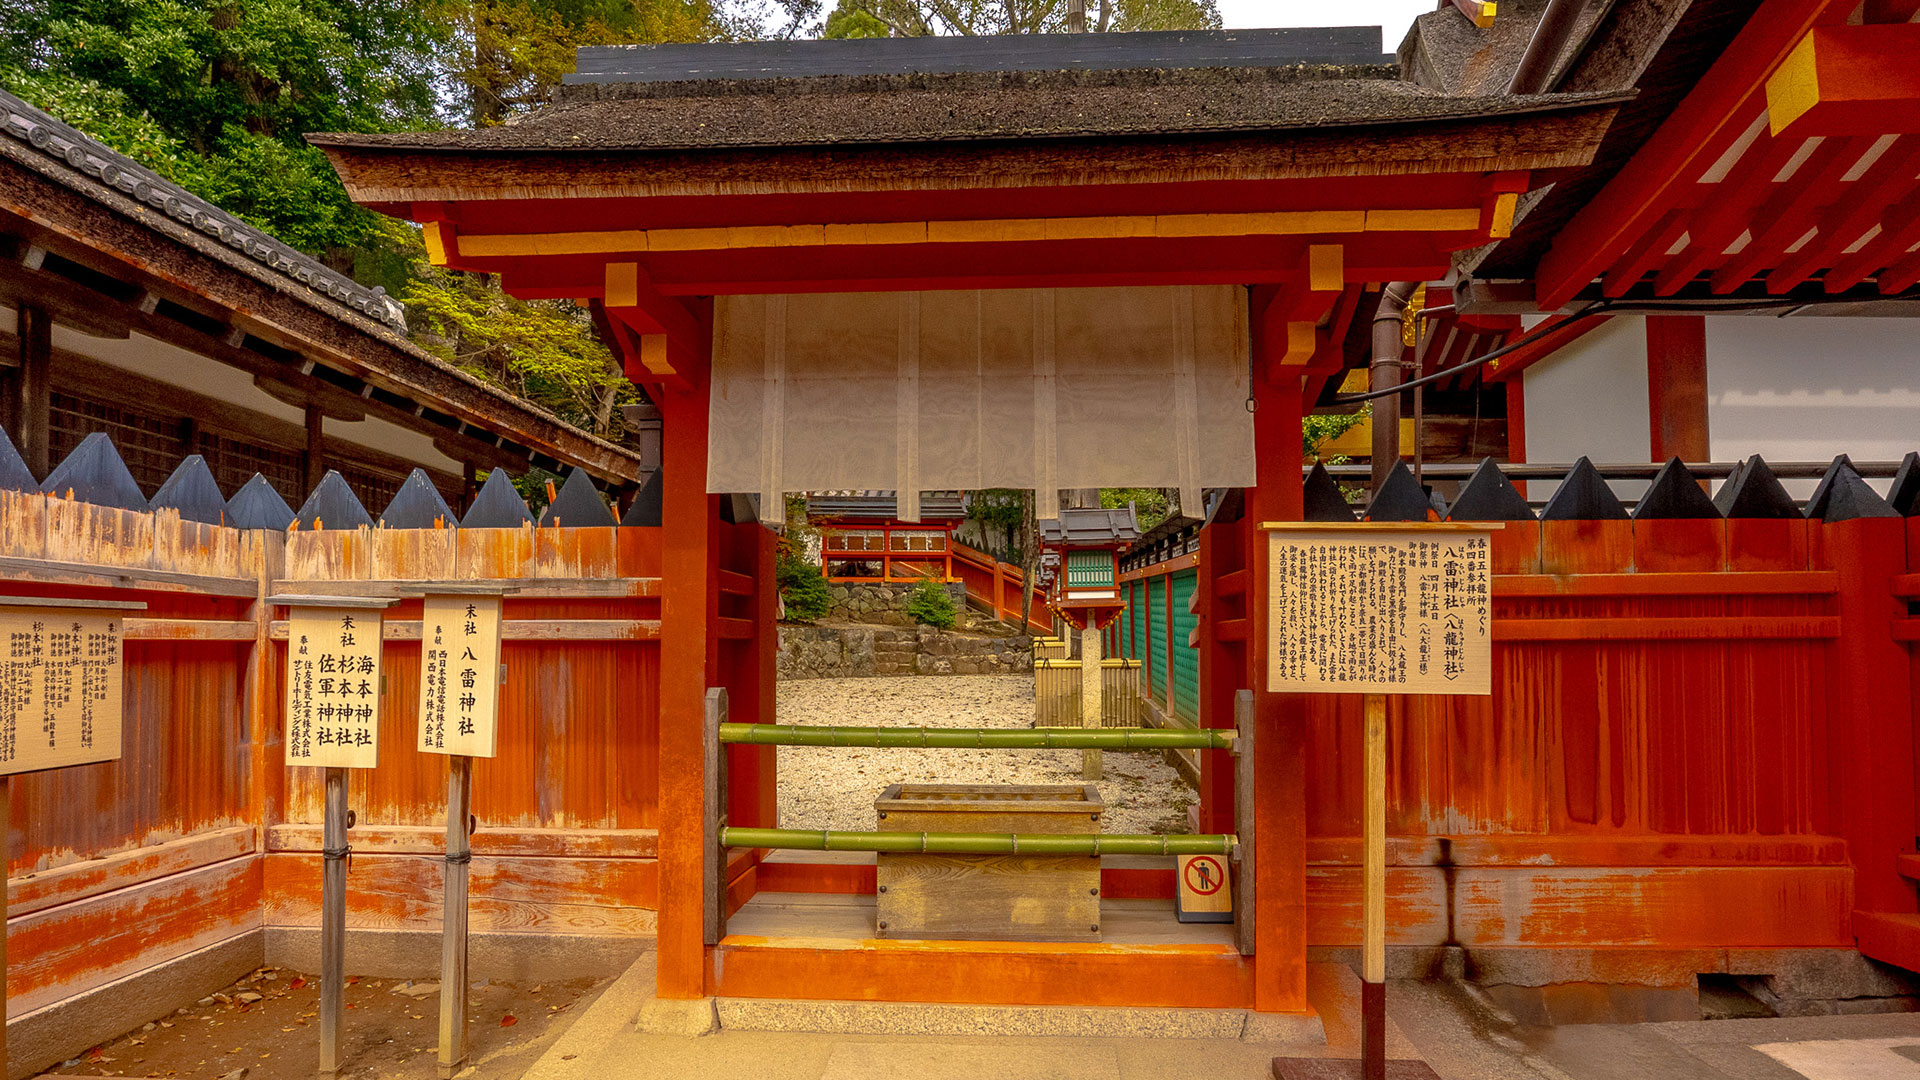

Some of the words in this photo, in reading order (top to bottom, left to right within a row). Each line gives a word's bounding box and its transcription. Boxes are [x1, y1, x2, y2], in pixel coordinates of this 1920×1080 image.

[1419, 542, 1428, 568] 御祭神
[1431, 543, 1439, 568] 例祭日
[1467, 539, 1476, 606] 第四番参拝所
[1431, 575, 1439, 620] 四月十五日
[1477, 538, 1487, 636] 春日五大龍神めぐり
[32, 622, 42, 667] 杉本神社
[71, 623, 80, 666] 海本神社
[299, 635, 308, 655] 奉献
[340, 615, 355, 647] 末社
[435, 625, 442, 645] 奉献
[464, 604, 477, 636] 末社
[291, 660, 303, 757] サントリーホールディングス株式会社
[316, 654, 336, 746] 佐軍神社
[335, 655, 355, 746] 杉本神社
[354, 656, 375, 747] 海本神社
[425, 650, 436, 746] 関西電力株式会社
[436, 650, 447, 748] 西日本電信電話株式会社
[458, 647, 477, 736] 八雷神社
